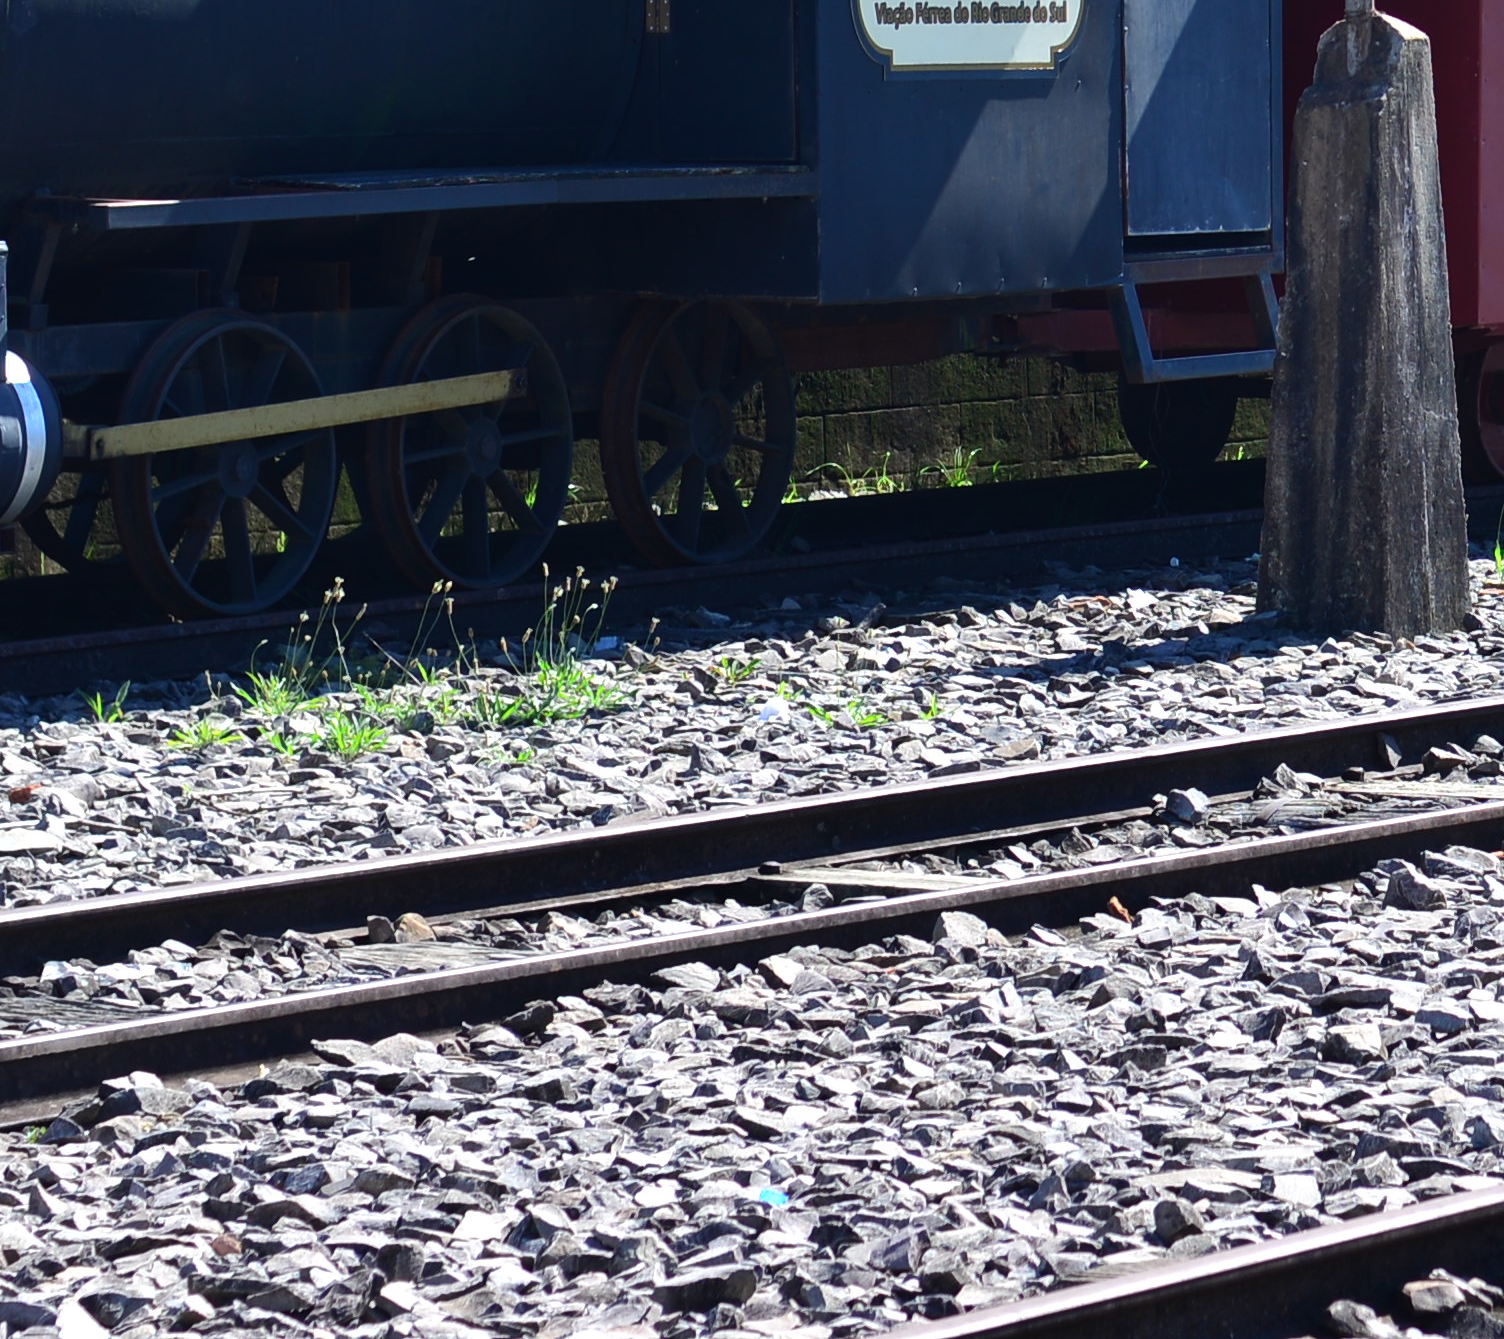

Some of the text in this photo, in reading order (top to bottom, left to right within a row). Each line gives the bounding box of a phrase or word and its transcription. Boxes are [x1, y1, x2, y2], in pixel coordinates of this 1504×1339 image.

[875, 0, 1067, 30] Viação Férrea do Rio Grande do Sul
